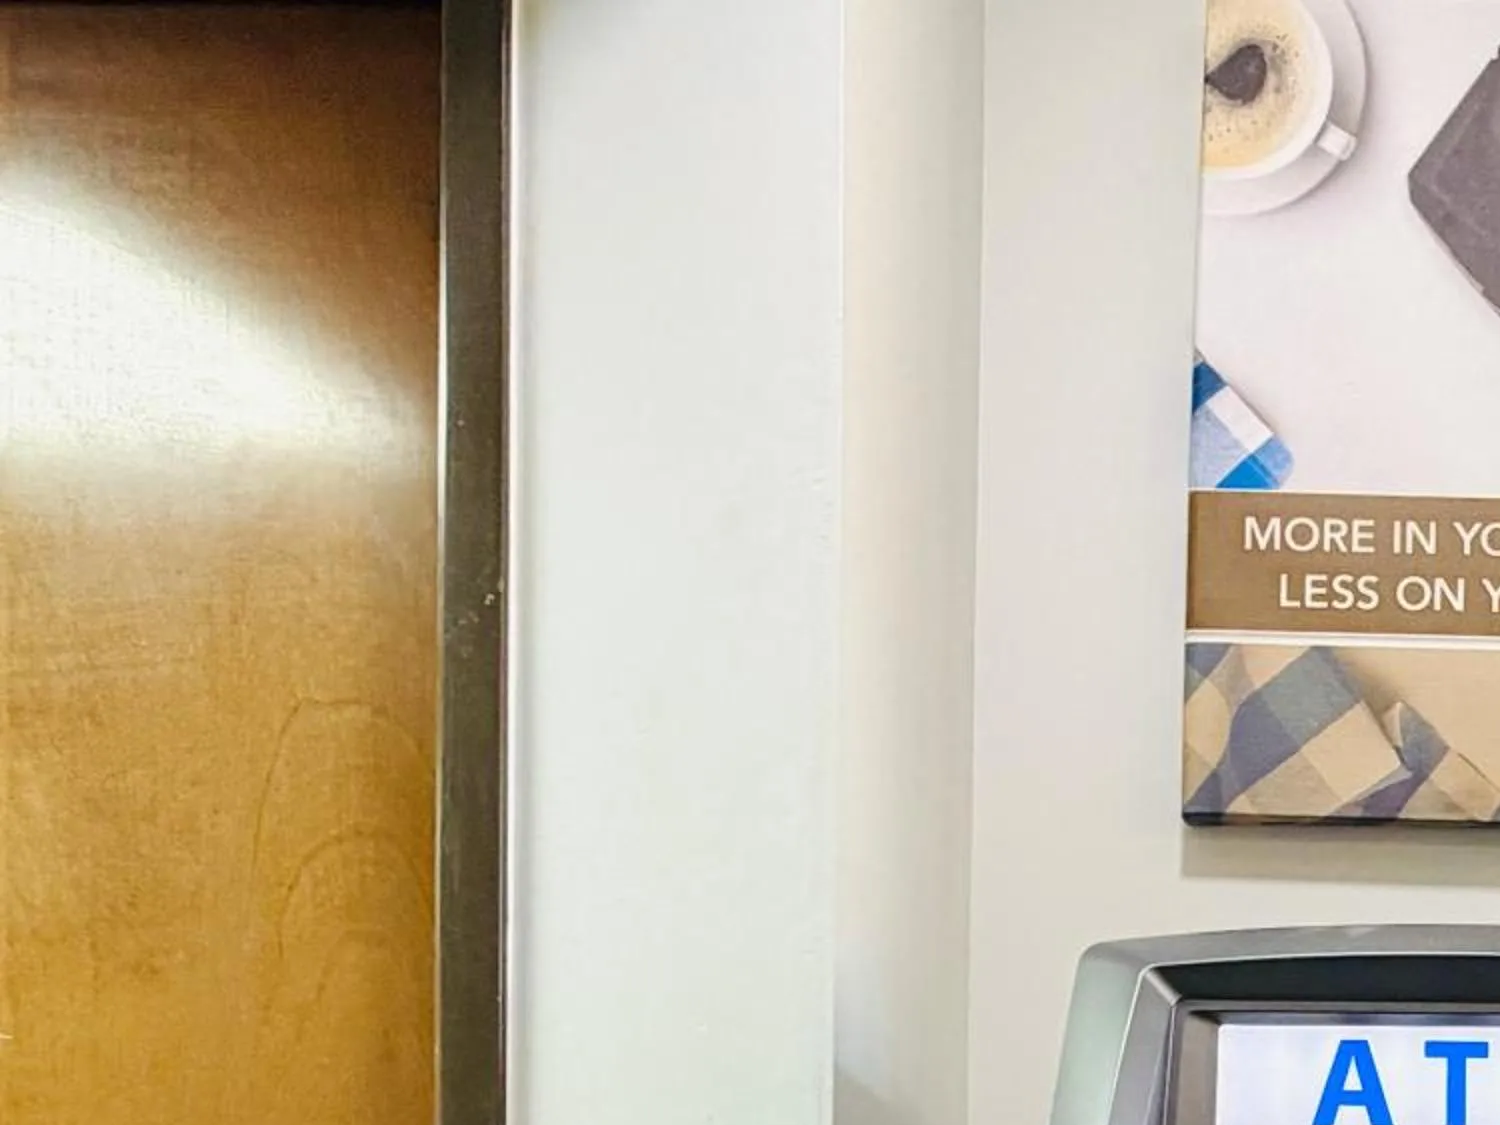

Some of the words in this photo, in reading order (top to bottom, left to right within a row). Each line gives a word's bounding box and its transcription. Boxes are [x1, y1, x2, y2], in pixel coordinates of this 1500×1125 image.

[1242, 516, 1376, 554] MORE
[1392, 520, 1437, 556] IN
[1278, 573, 1380, 611] LESS
[1396, 575, 1466, 613] ON
